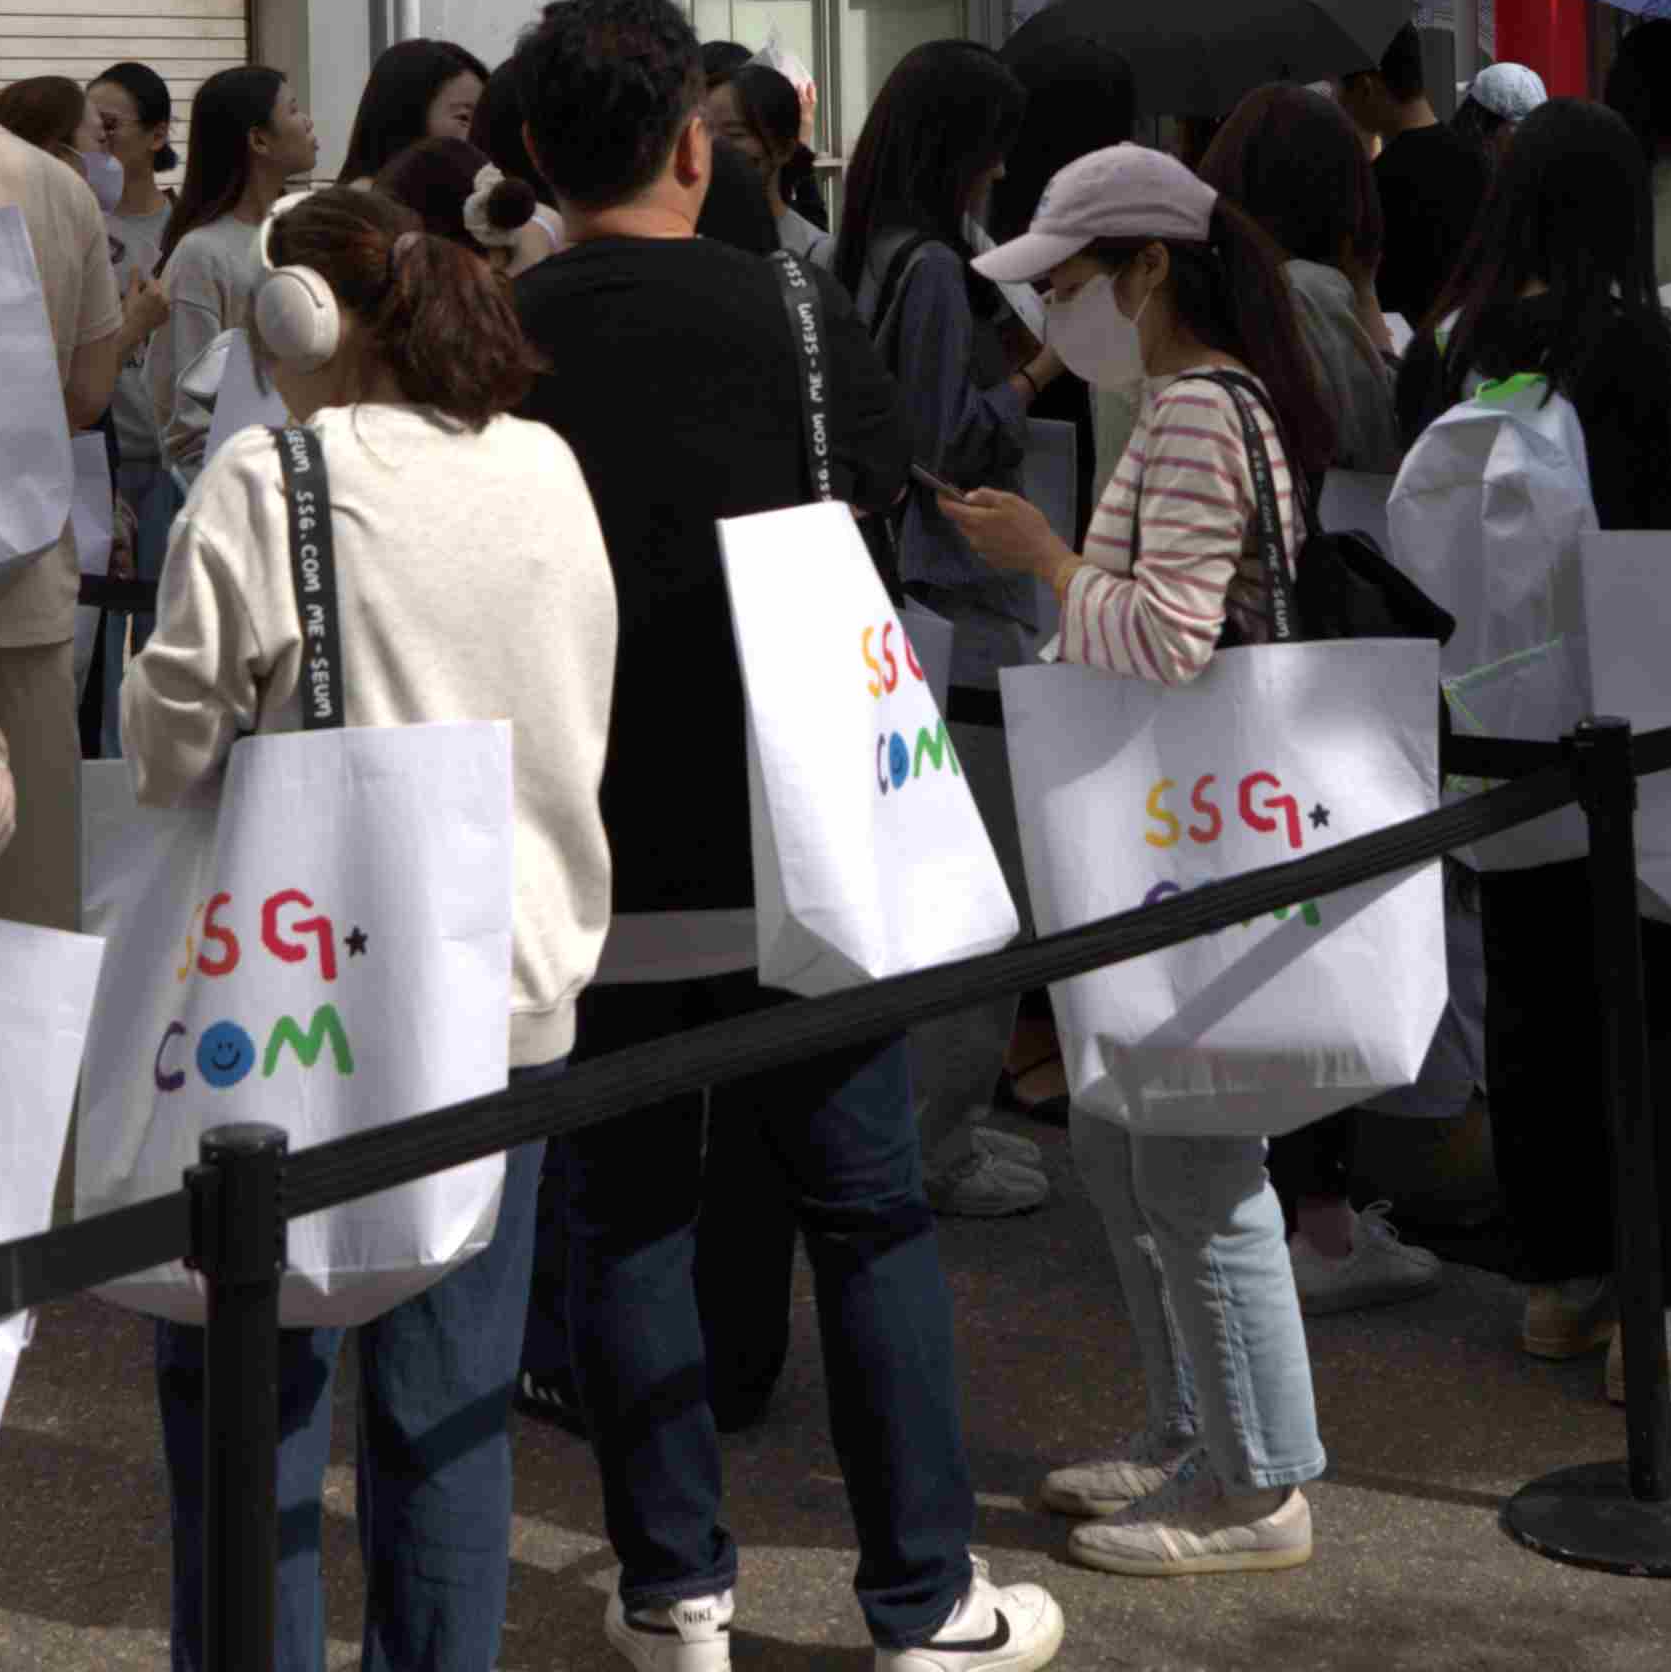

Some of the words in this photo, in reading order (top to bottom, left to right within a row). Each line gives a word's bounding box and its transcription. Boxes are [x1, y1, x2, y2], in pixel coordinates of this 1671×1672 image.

[294, 490, 322, 592] SSG.COM
[305, 603, 334, 718] ME-SEUM
[875, 716, 960, 796] COM
[154, 1003, 354, 1093] COM
